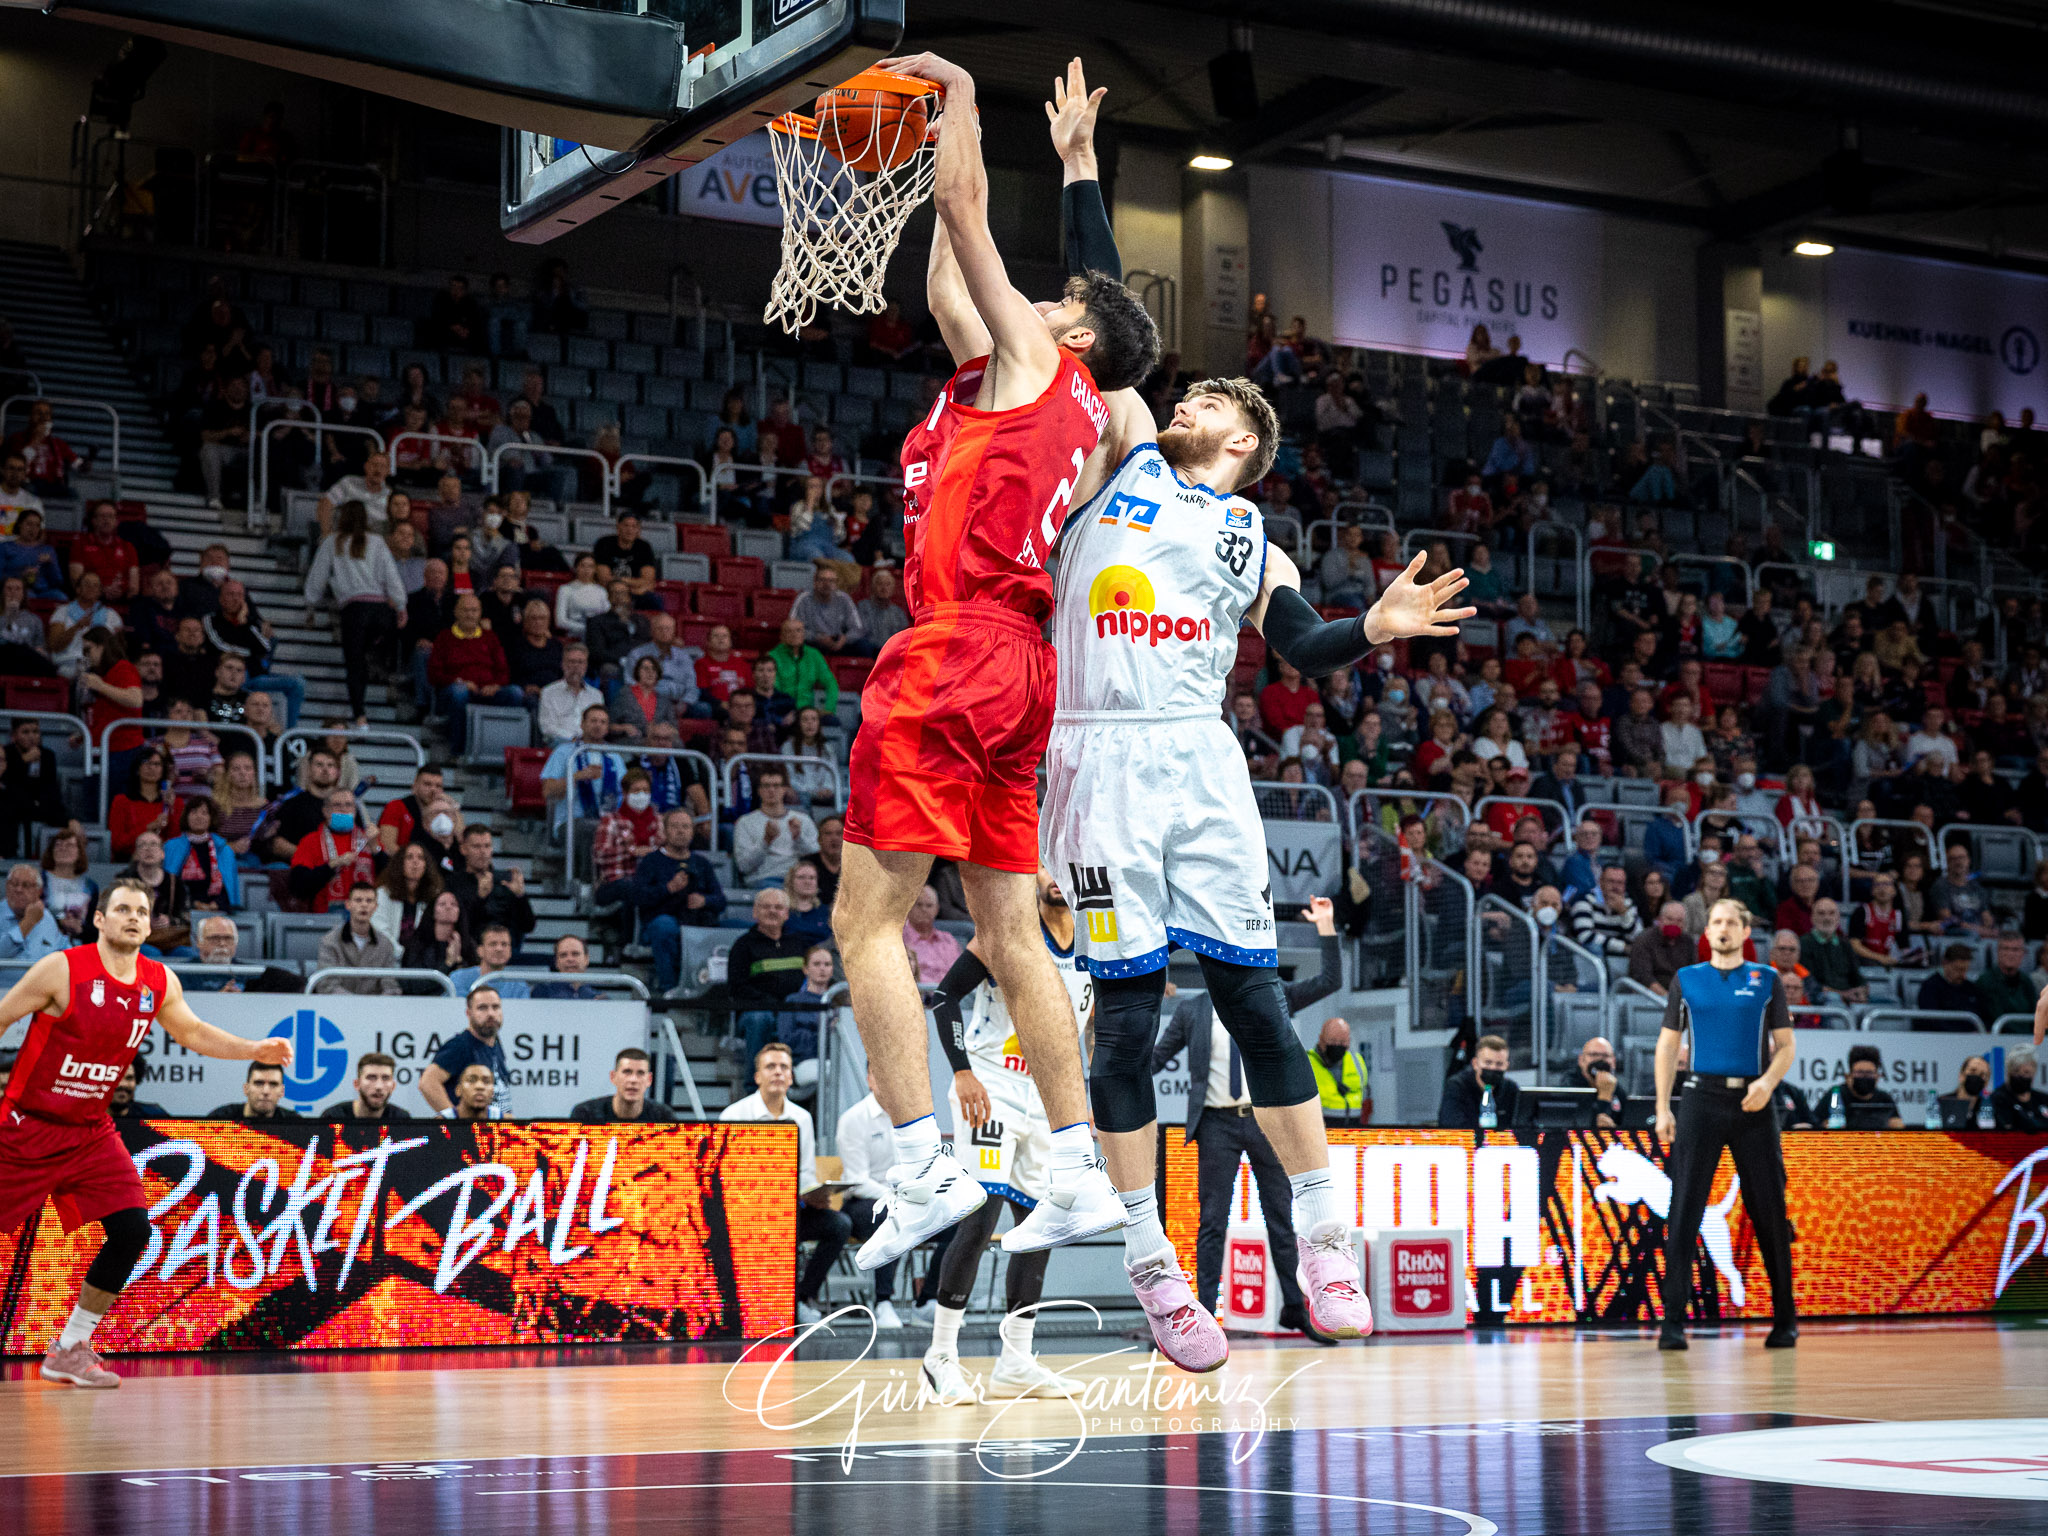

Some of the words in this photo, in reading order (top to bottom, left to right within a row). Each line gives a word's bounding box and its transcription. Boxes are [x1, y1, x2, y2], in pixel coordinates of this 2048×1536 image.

[1381, 263, 1558, 320] PEGASUS
[1216, 531, 1254, 577] 33
[1096, 610, 1210, 648] nippon
[1080, 984, 1092, 1012] 3
[126, 1018, 149, 1048] 17
[59, 1053, 124, 1082] bros
[1233, 1249, 1263, 1271] RHÖN
[1398, 1248, 1446, 1272] RHÖN
[1397, 1272, 1446, 1287] SPRUDEL
